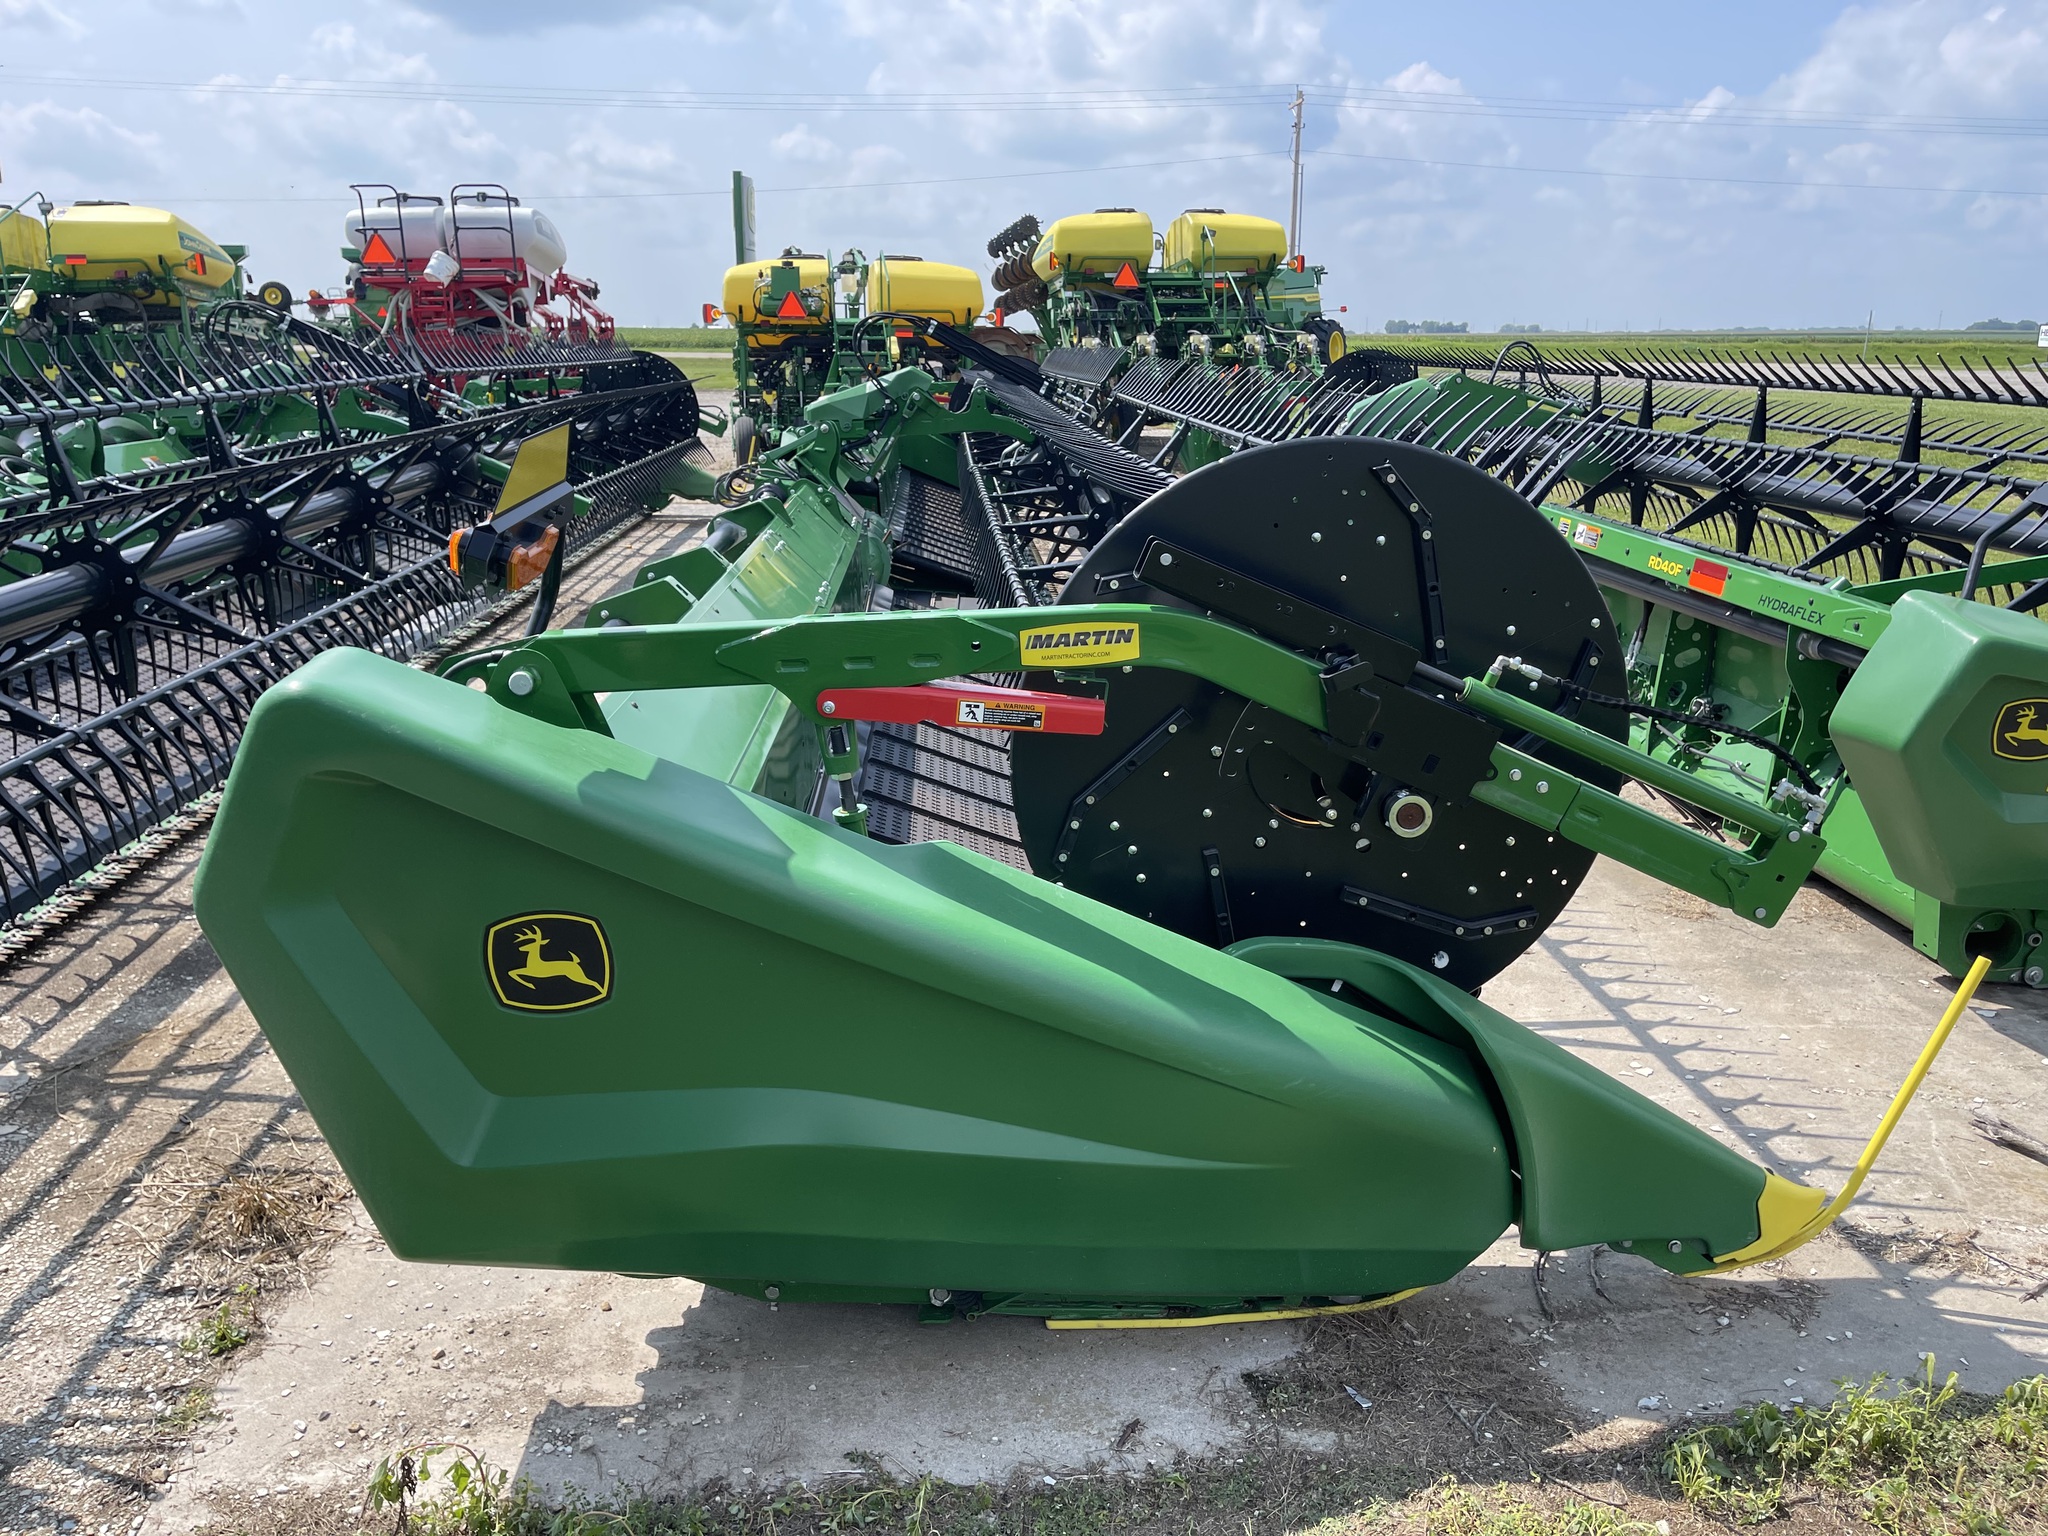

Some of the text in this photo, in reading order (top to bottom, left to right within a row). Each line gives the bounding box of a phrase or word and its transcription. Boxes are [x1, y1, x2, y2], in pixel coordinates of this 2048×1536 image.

[1648, 555, 1684, 576] RD40F
[1758, 594, 1826, 625] HYDRAFLEX
[1029, 629, 1134, 650] MARTIN
[1041, 651, 1111, 661] MARTINTRACTORINC.COM
[1003, 703, 1036, 711] WARNING
